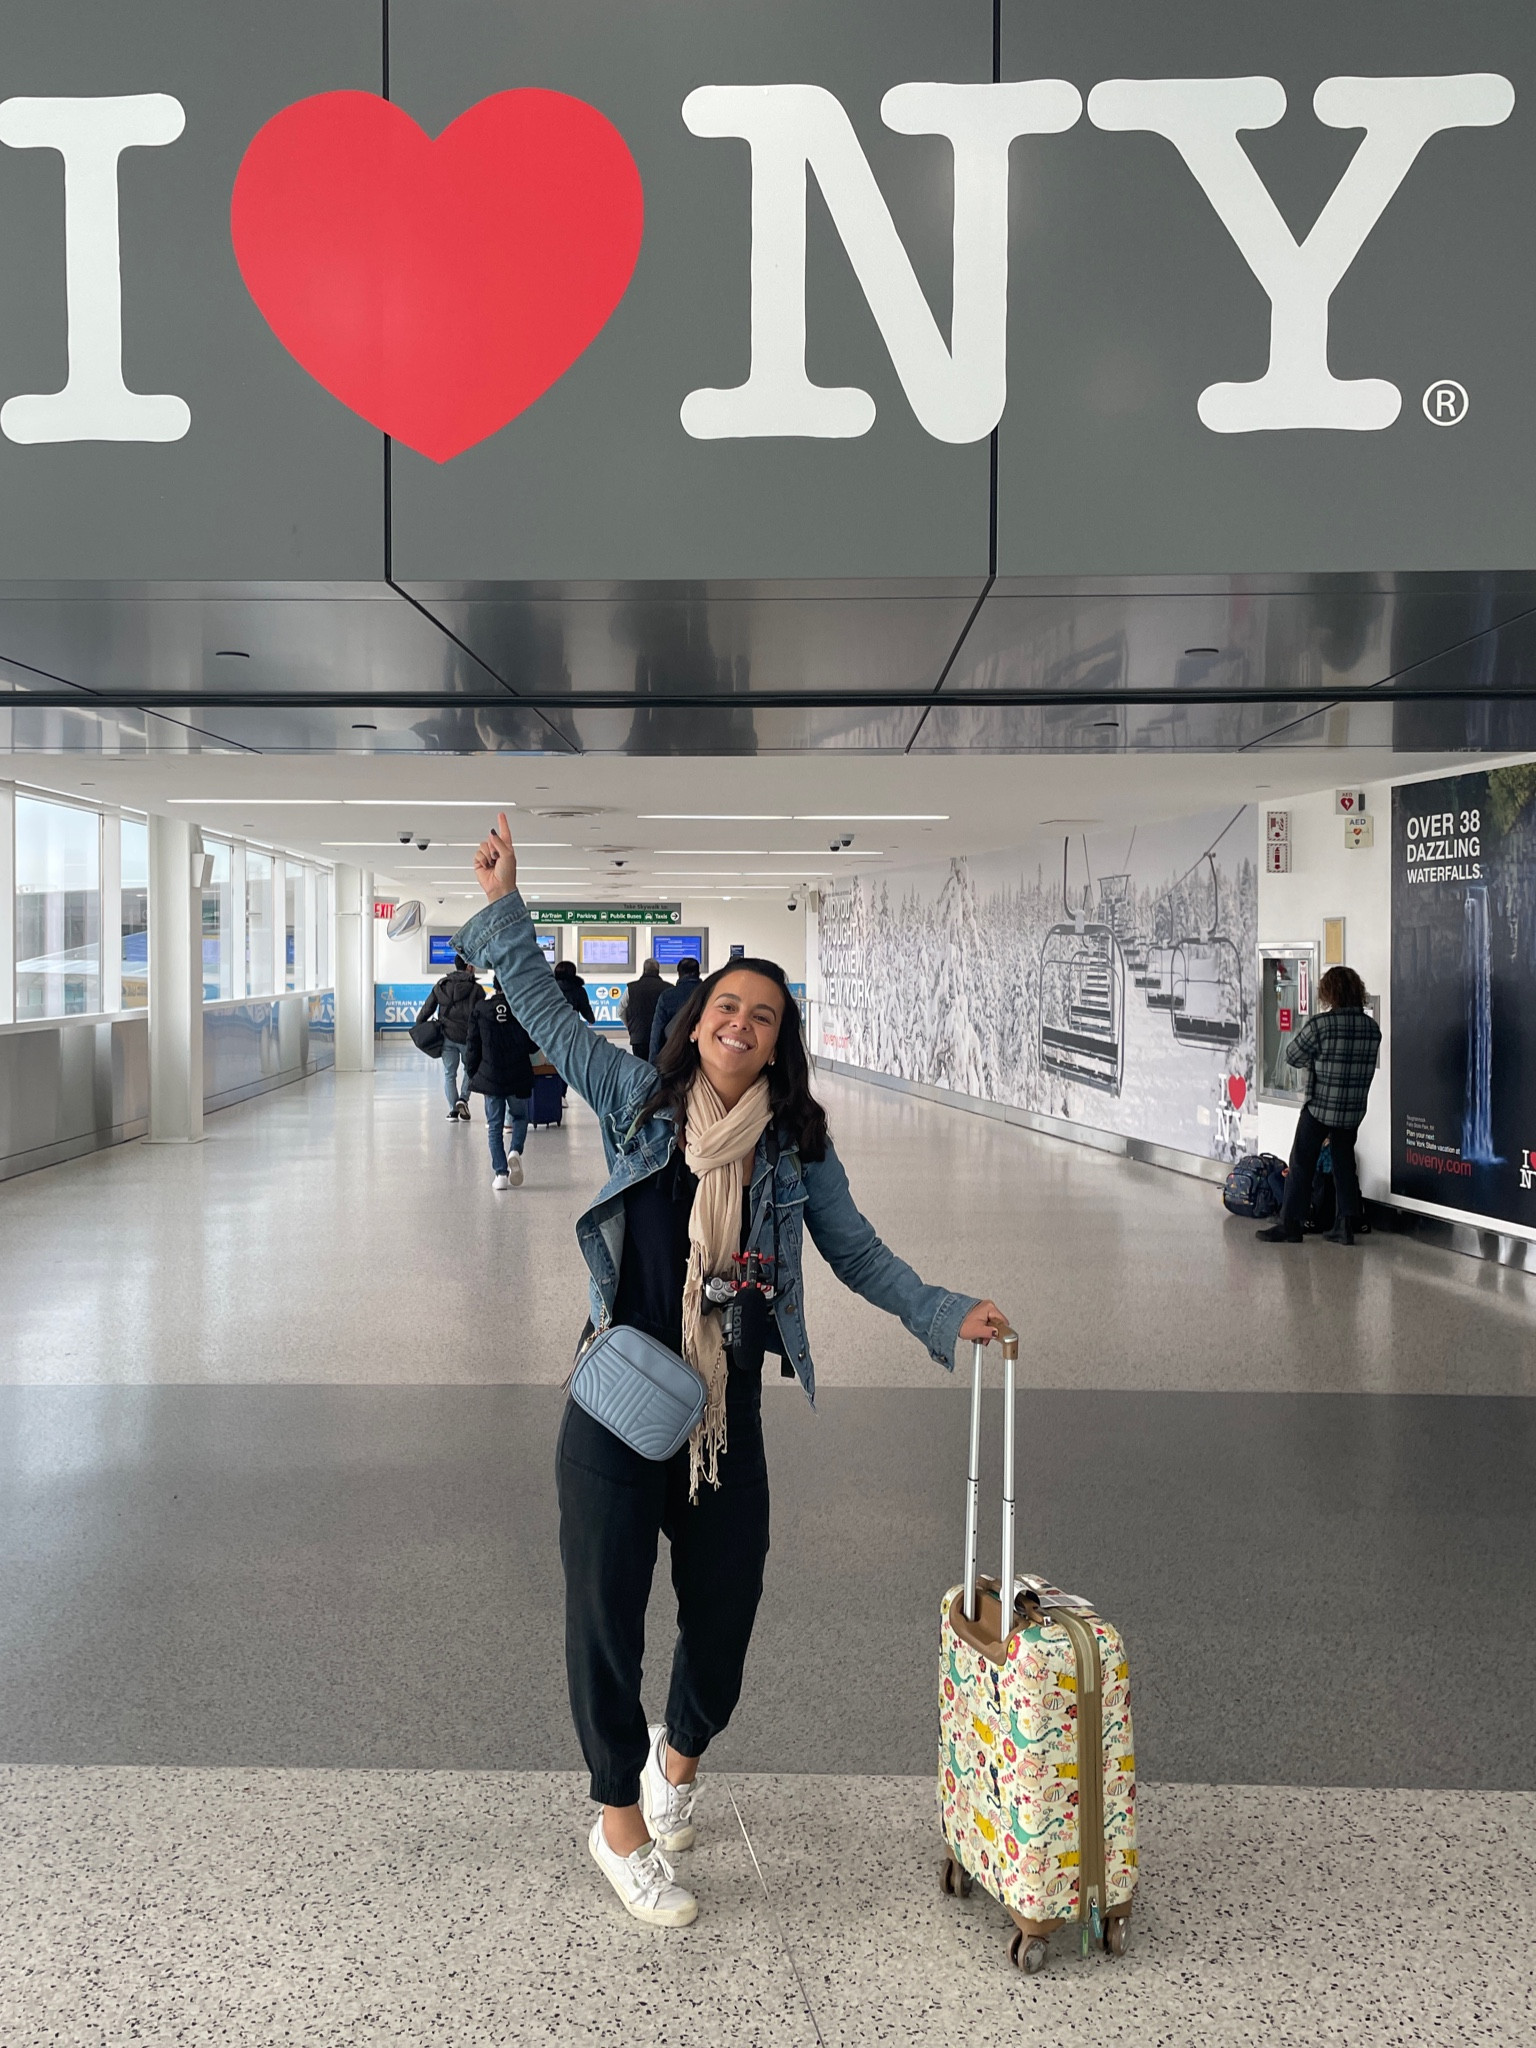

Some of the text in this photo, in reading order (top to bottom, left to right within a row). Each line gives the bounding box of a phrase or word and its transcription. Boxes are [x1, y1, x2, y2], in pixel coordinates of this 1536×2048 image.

[0, 73, 1515, 444] I NY
[1407, 809, 1481, 840] OVER 38
[1407, 836, 1481, 863] DAZZLING
[1407, 863, 1484, 884] WATERFALLS.
[374, 903, 394, 918] EXIT
[541, 911, 563, 919] AirTrain
[576, 911, 598, 920] Parking
[823, 924, 857, 946] THOUGHT
[842, 979, 872, 1008] YORK
[385, 1006, 421, 1023] SKY
[1218, 1073, 1228, 1106] I
[1406, 1129, 1416, 1137] Plan
[1425, 1142, 1437, 1150] State
[1437, 1145, 1456, 1154] vacation
[1406, 1148, 1472, 1176] iloveny.com
[1522, 1149, 1530, 1169] I
[1519, 1168, 1536, 1189] N
[733, 1305, 742, 1347] RØDE
